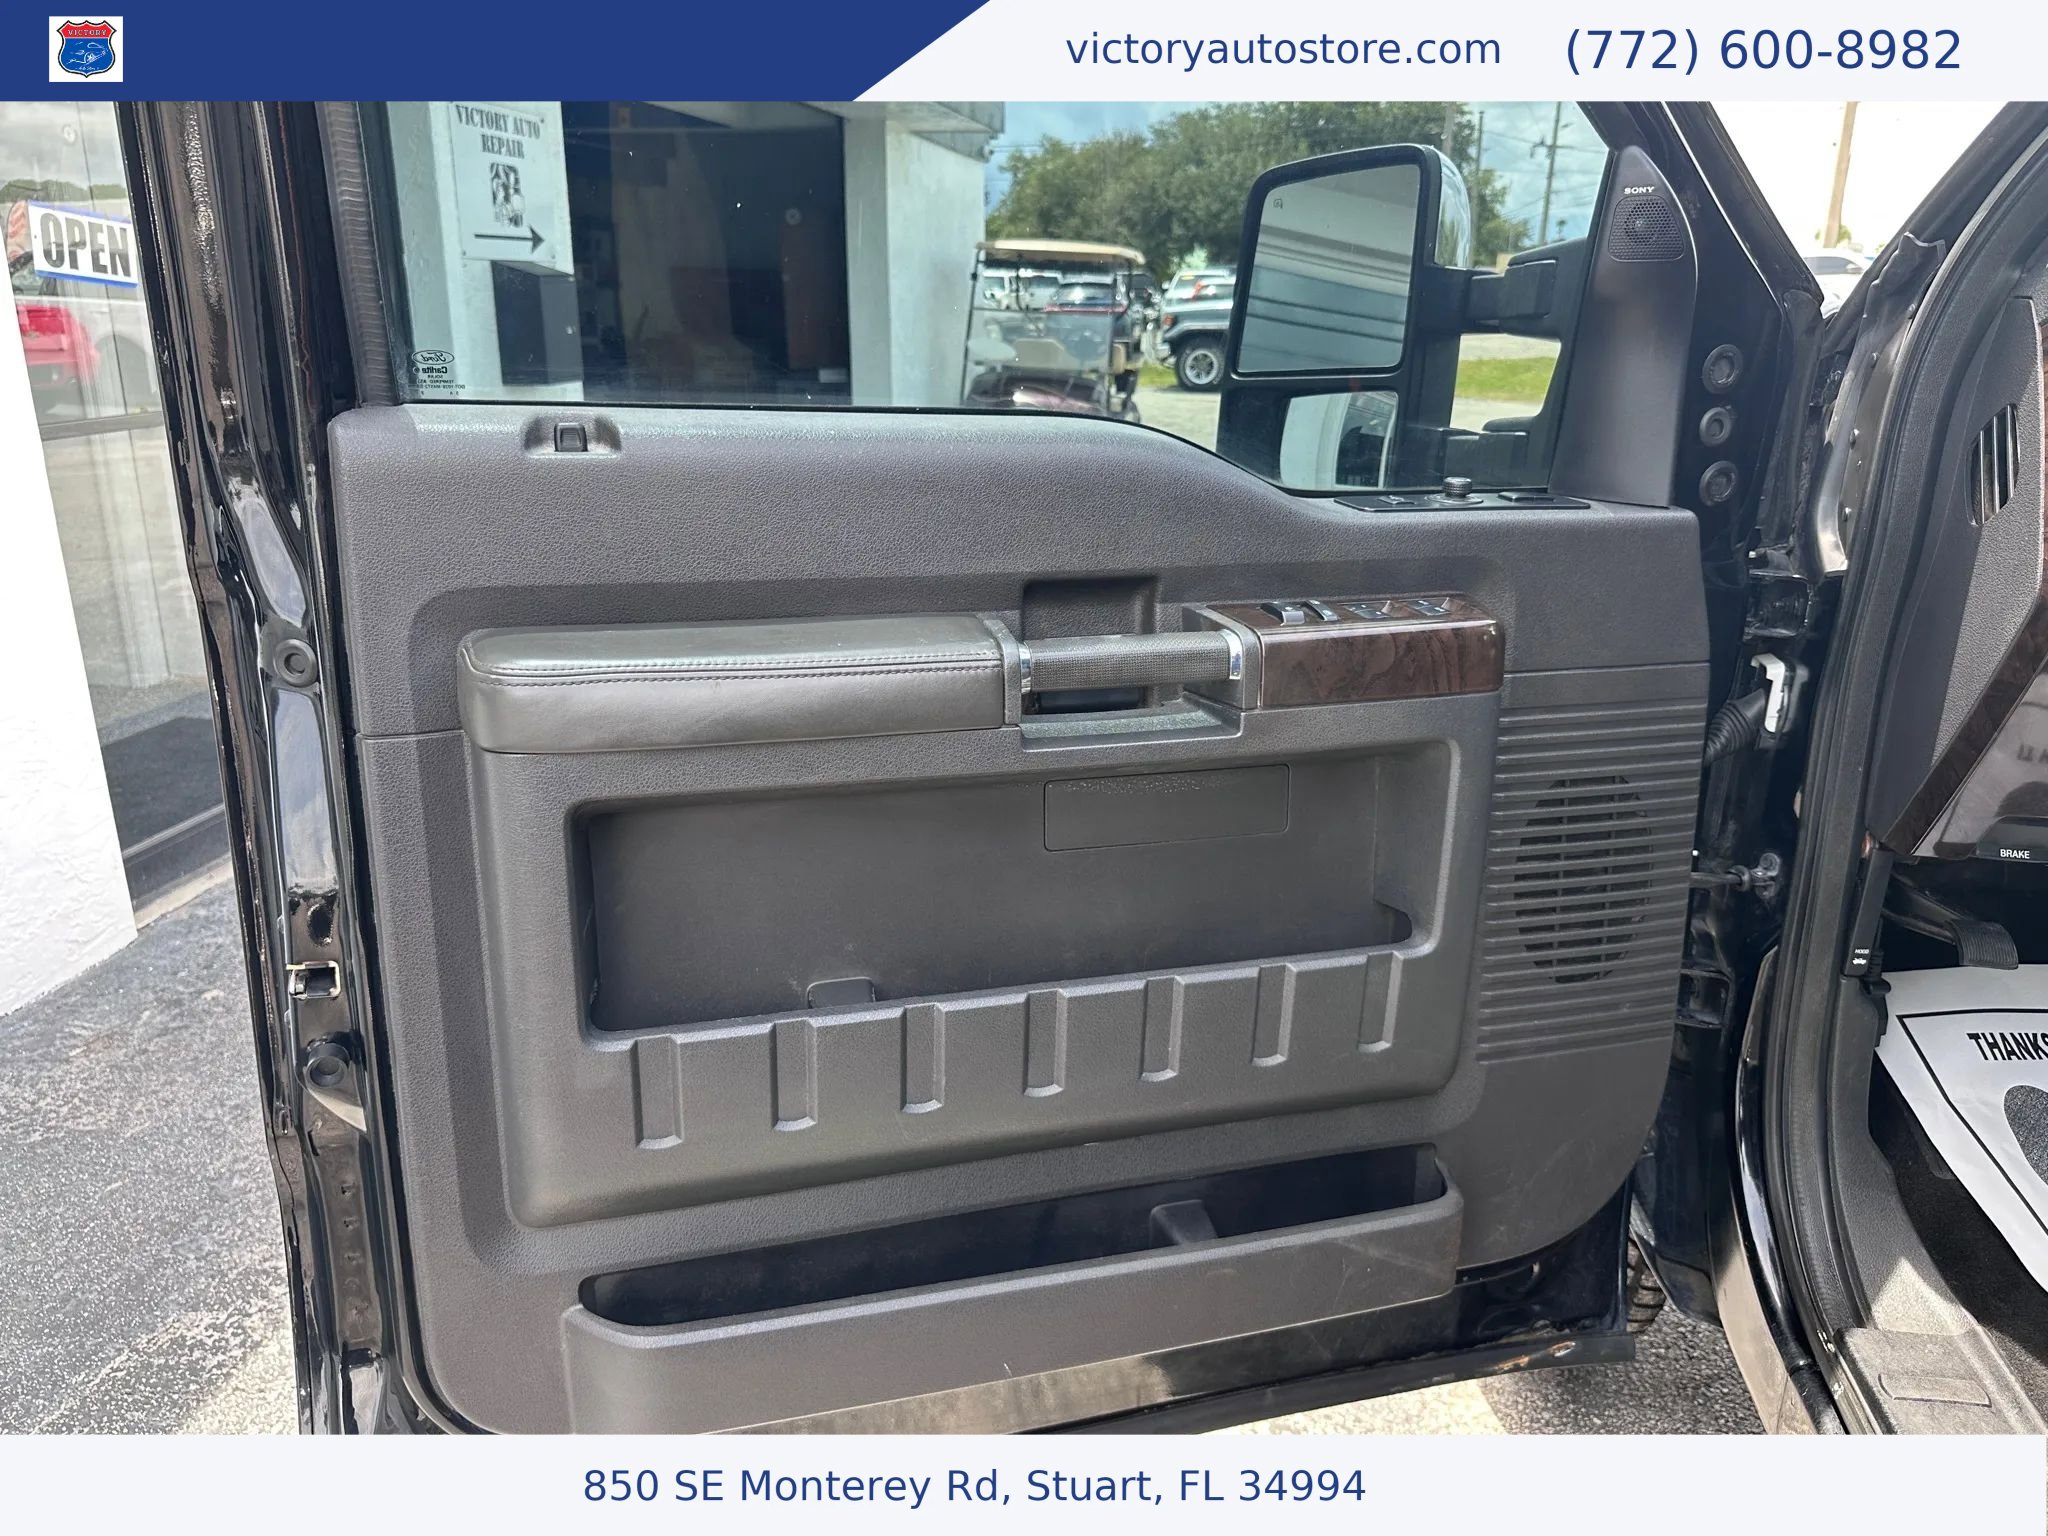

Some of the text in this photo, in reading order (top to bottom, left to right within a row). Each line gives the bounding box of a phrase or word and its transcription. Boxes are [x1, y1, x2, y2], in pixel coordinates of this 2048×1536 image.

[456, 104, 541, 140] VICTORY AUTO
[481, 134, 525, 159] REPAIR
[1624, 186, 1655, 194] SONY
[40, 212, 131, 278] OPEN
[2000, 848, 2031, 860] BRAKE
